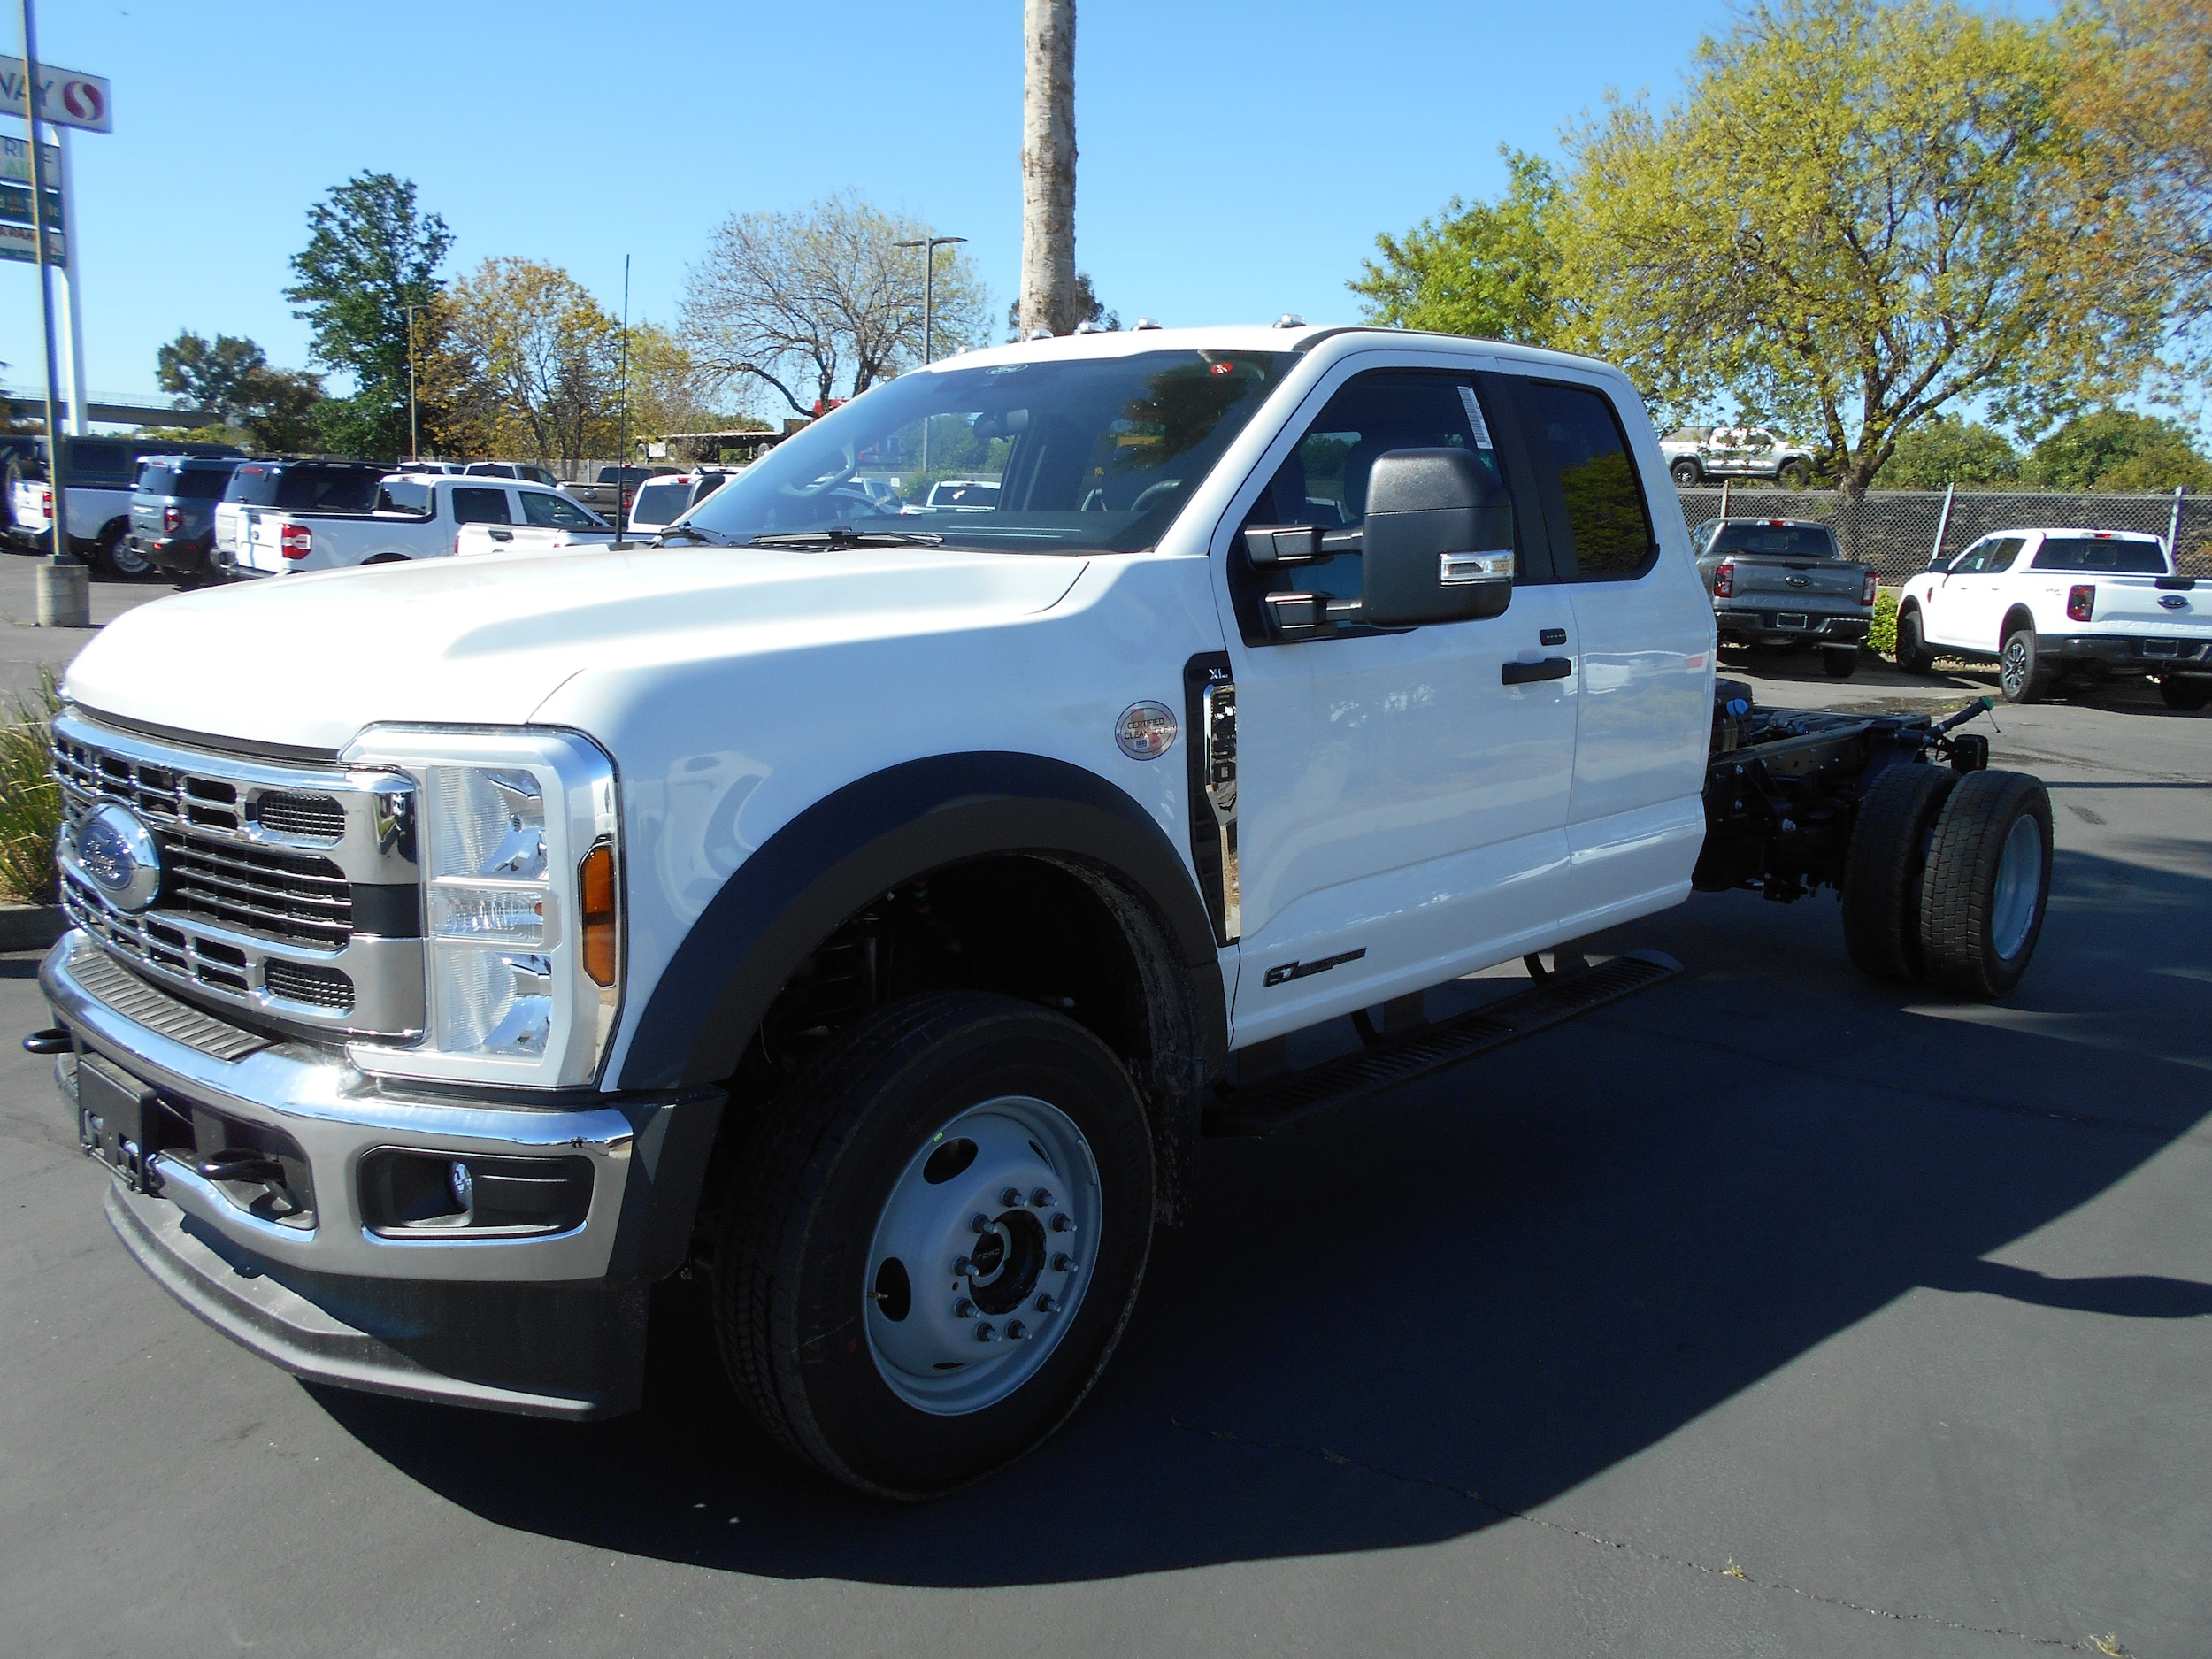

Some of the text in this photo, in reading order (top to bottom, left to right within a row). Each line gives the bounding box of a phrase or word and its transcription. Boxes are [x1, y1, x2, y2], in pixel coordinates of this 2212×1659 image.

[1208, 668, 1228, 680] XL
[1126, 718, 1165, 730] CERTIFIED
[1124, 729, 1150, 740] CLEAN
